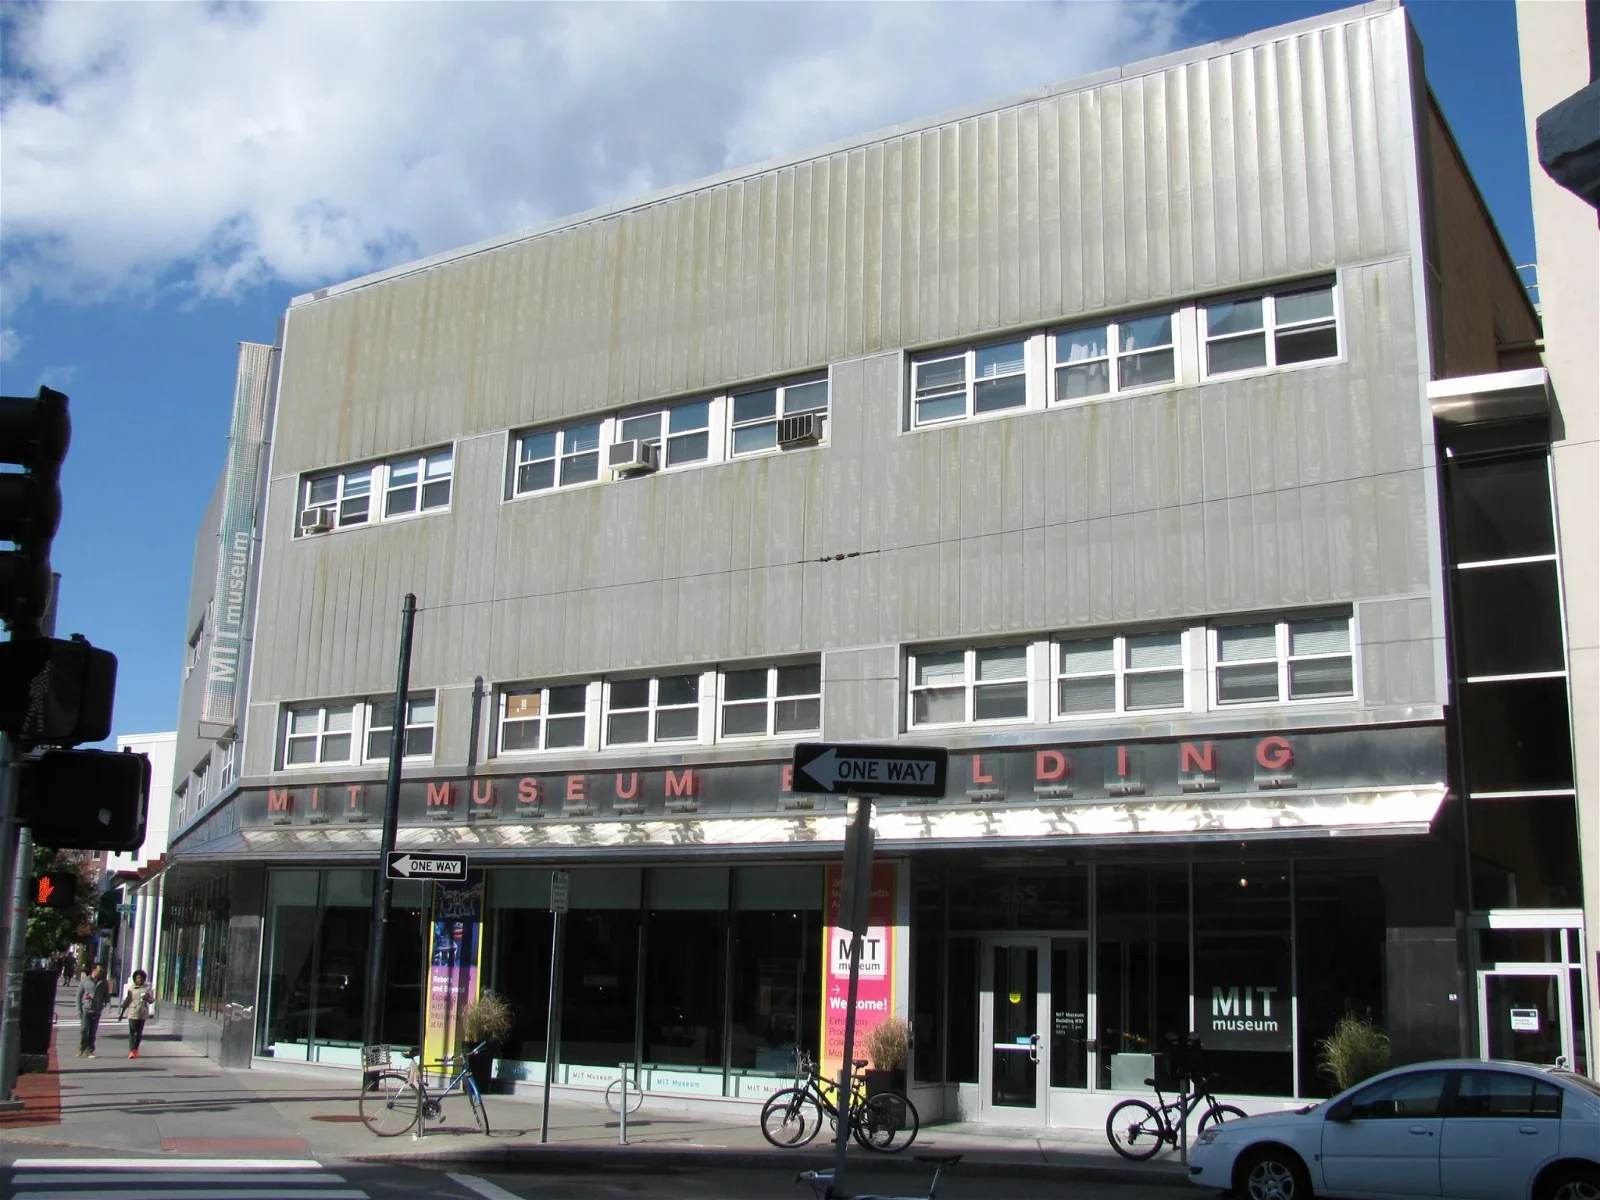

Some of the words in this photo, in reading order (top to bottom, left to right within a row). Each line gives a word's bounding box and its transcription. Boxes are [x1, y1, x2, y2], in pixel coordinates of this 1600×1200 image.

[209, 625, 239, 683] MIT
[226, 531, 249, 625] museum
[838, 760, 879, 779] ONE
[887, 762, 930, 781] WAY
[268, 785, 362, 811] MIT
[426, 770, 693, 806] MUSEUM
[411, 860, 433, 871] ONE
[436, 862, 458, 872] WAY
[432, 984, 443, 992] and
[1212, 986, 1278, 1017] MIT
[1212, 1019, 1278, 1032] museum
[572, 1071, 585, 1079] MIT
[587, 1073, 614, 1081] Museum
[672, 1079, 700, 1088] Museum
[747, 1084, 761, 1092] MIT
